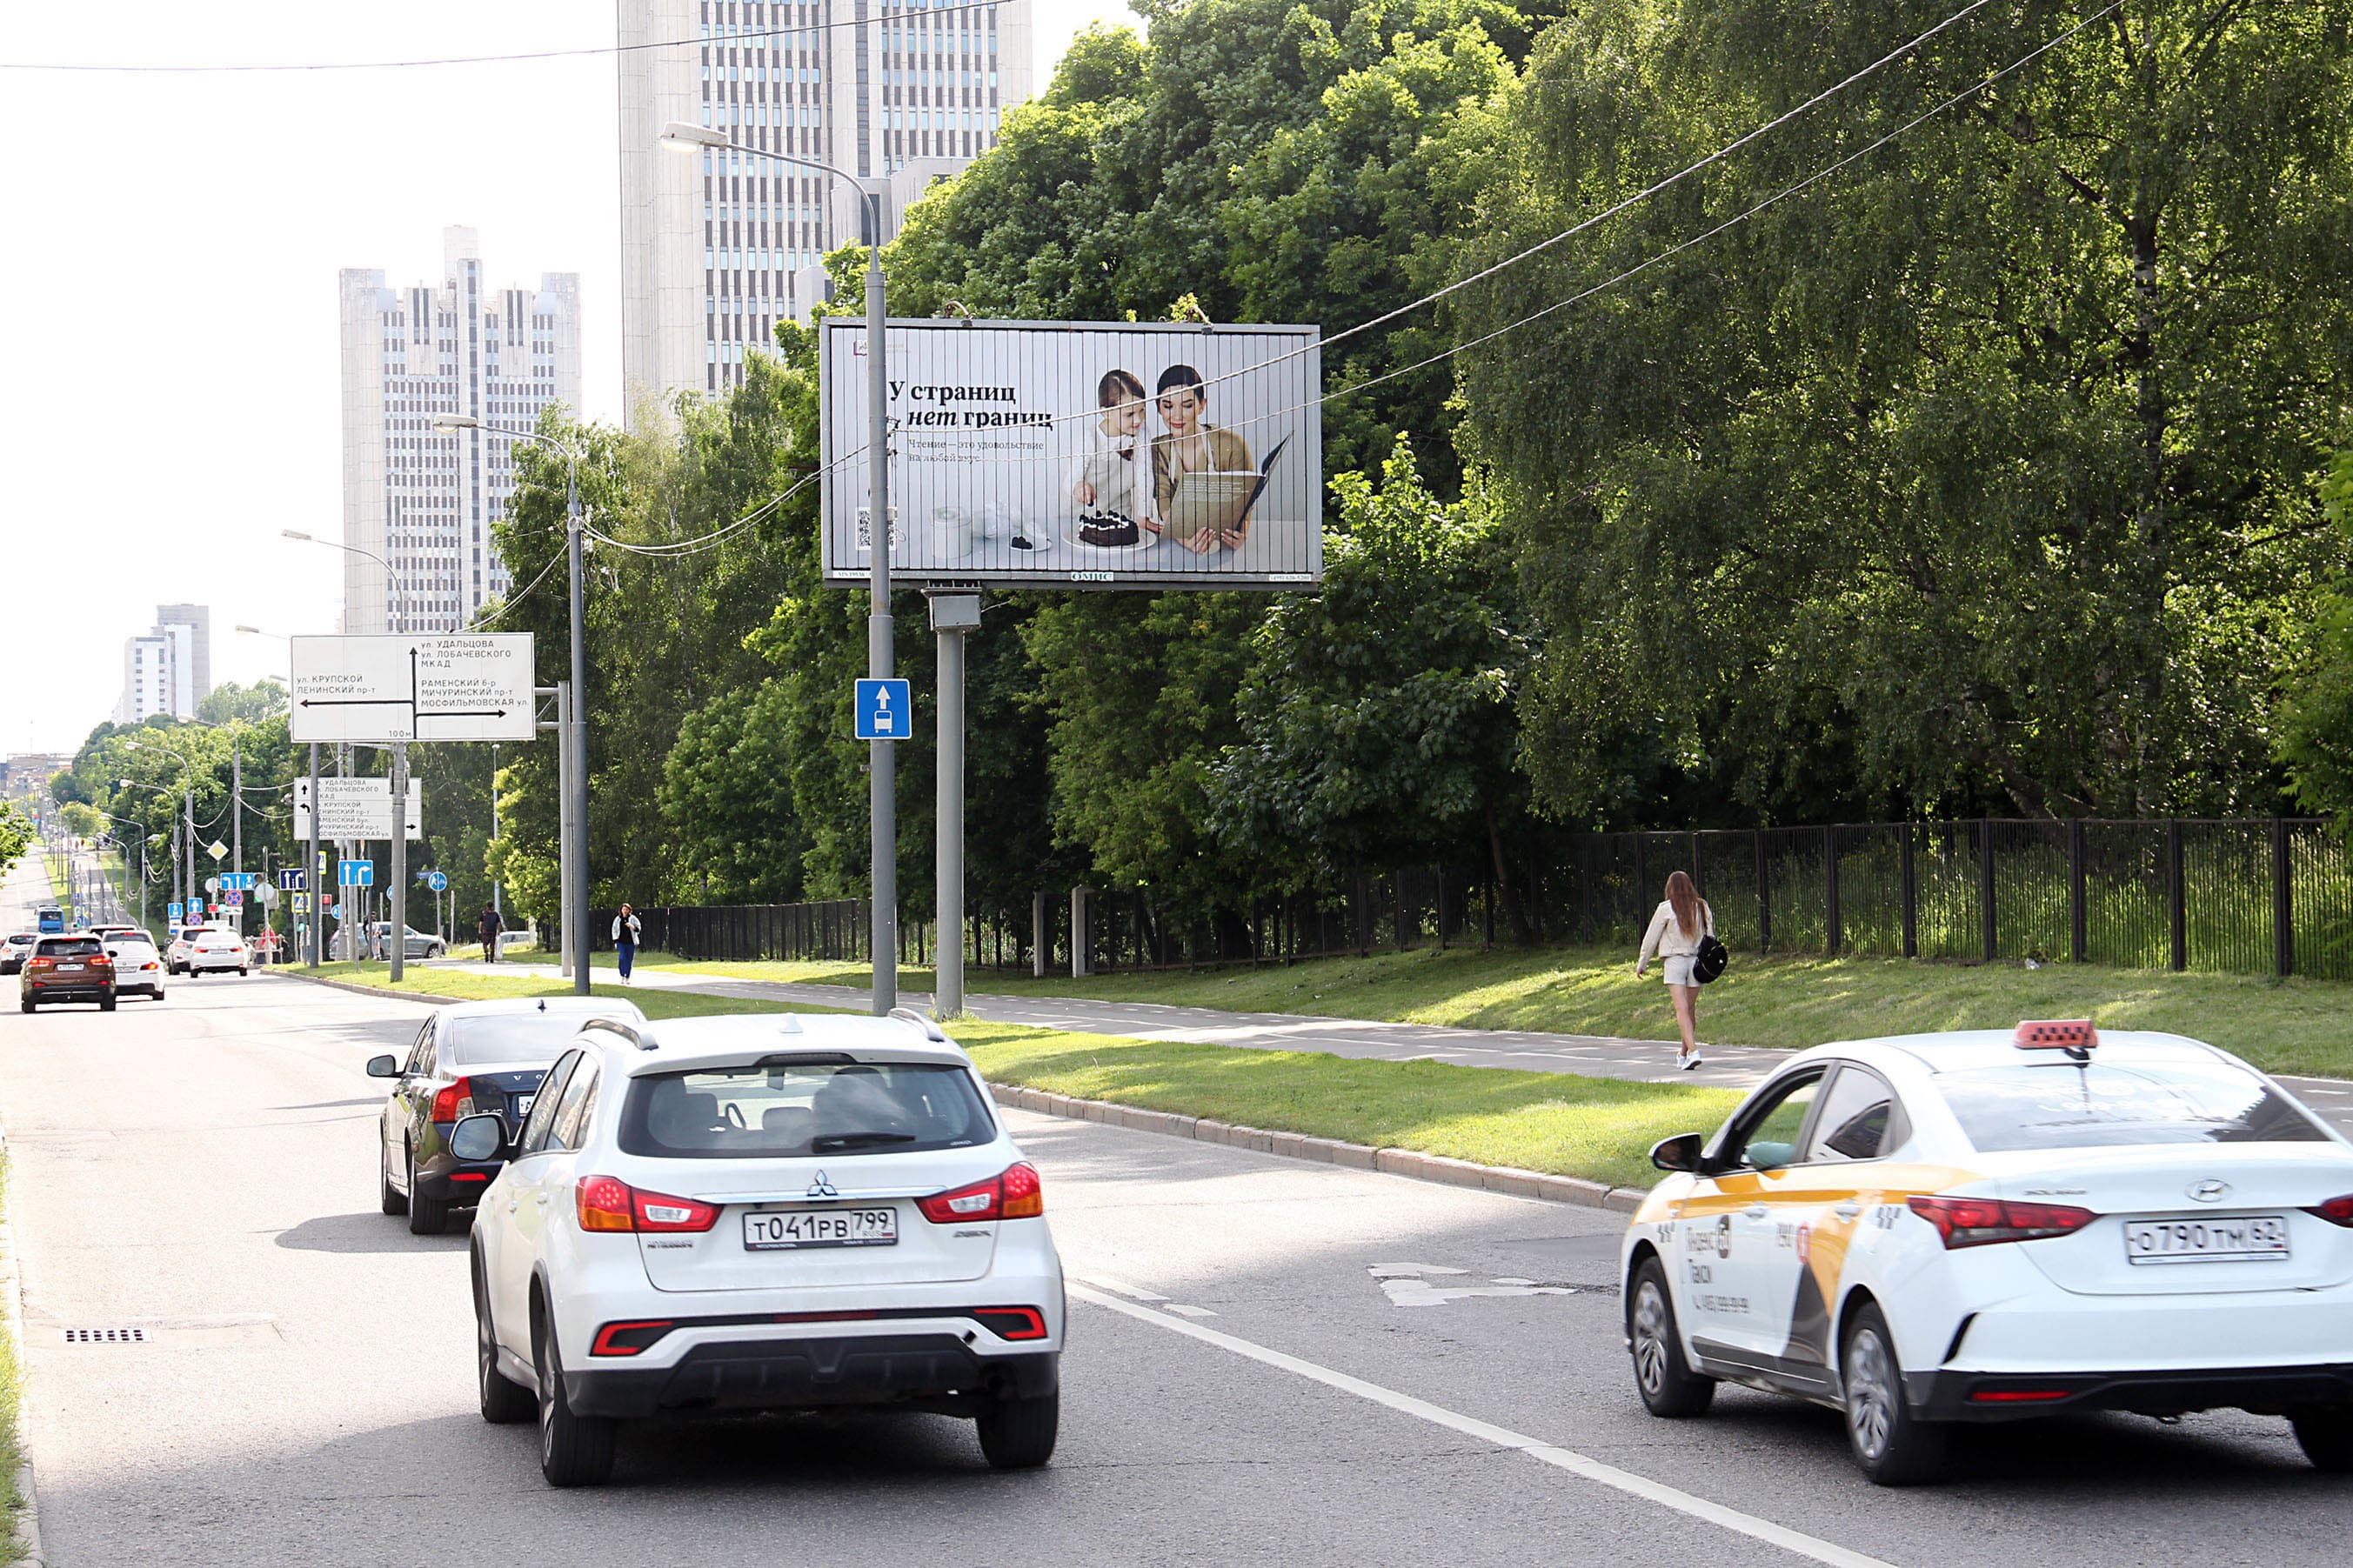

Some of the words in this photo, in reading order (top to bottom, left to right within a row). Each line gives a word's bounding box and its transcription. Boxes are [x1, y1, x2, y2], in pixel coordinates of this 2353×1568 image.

[888, 380, 906, 401] У
[911, 385, 1016, 406] страниц
[908, 410, 958, 426] нет
[964, 411, 1053, 431] границ
[908, 439, 946, 449] Чтение
[977, 441, 1044, 451] удовольствие
[437, 640, 494, 649] УДАЛЬЦОВА
[437, 650, 511, 658] ЛОБАЧЕВСКОГО
[421, 678, 479, 687] РАМЕНСКИЙ
[482, 680, 496, 689] б-р
[297, 685, 355, 694] ЛЕНИНСКИЙ
[421, 688, 491, 697] МИЧУРИНСКИЙ
[421, 698, 514, 707] МОСФИЛЬМОВСКАЯ
[753, 1215, 847, 1240] Т041РВ
[853, 1211, 888, 1230] 799
